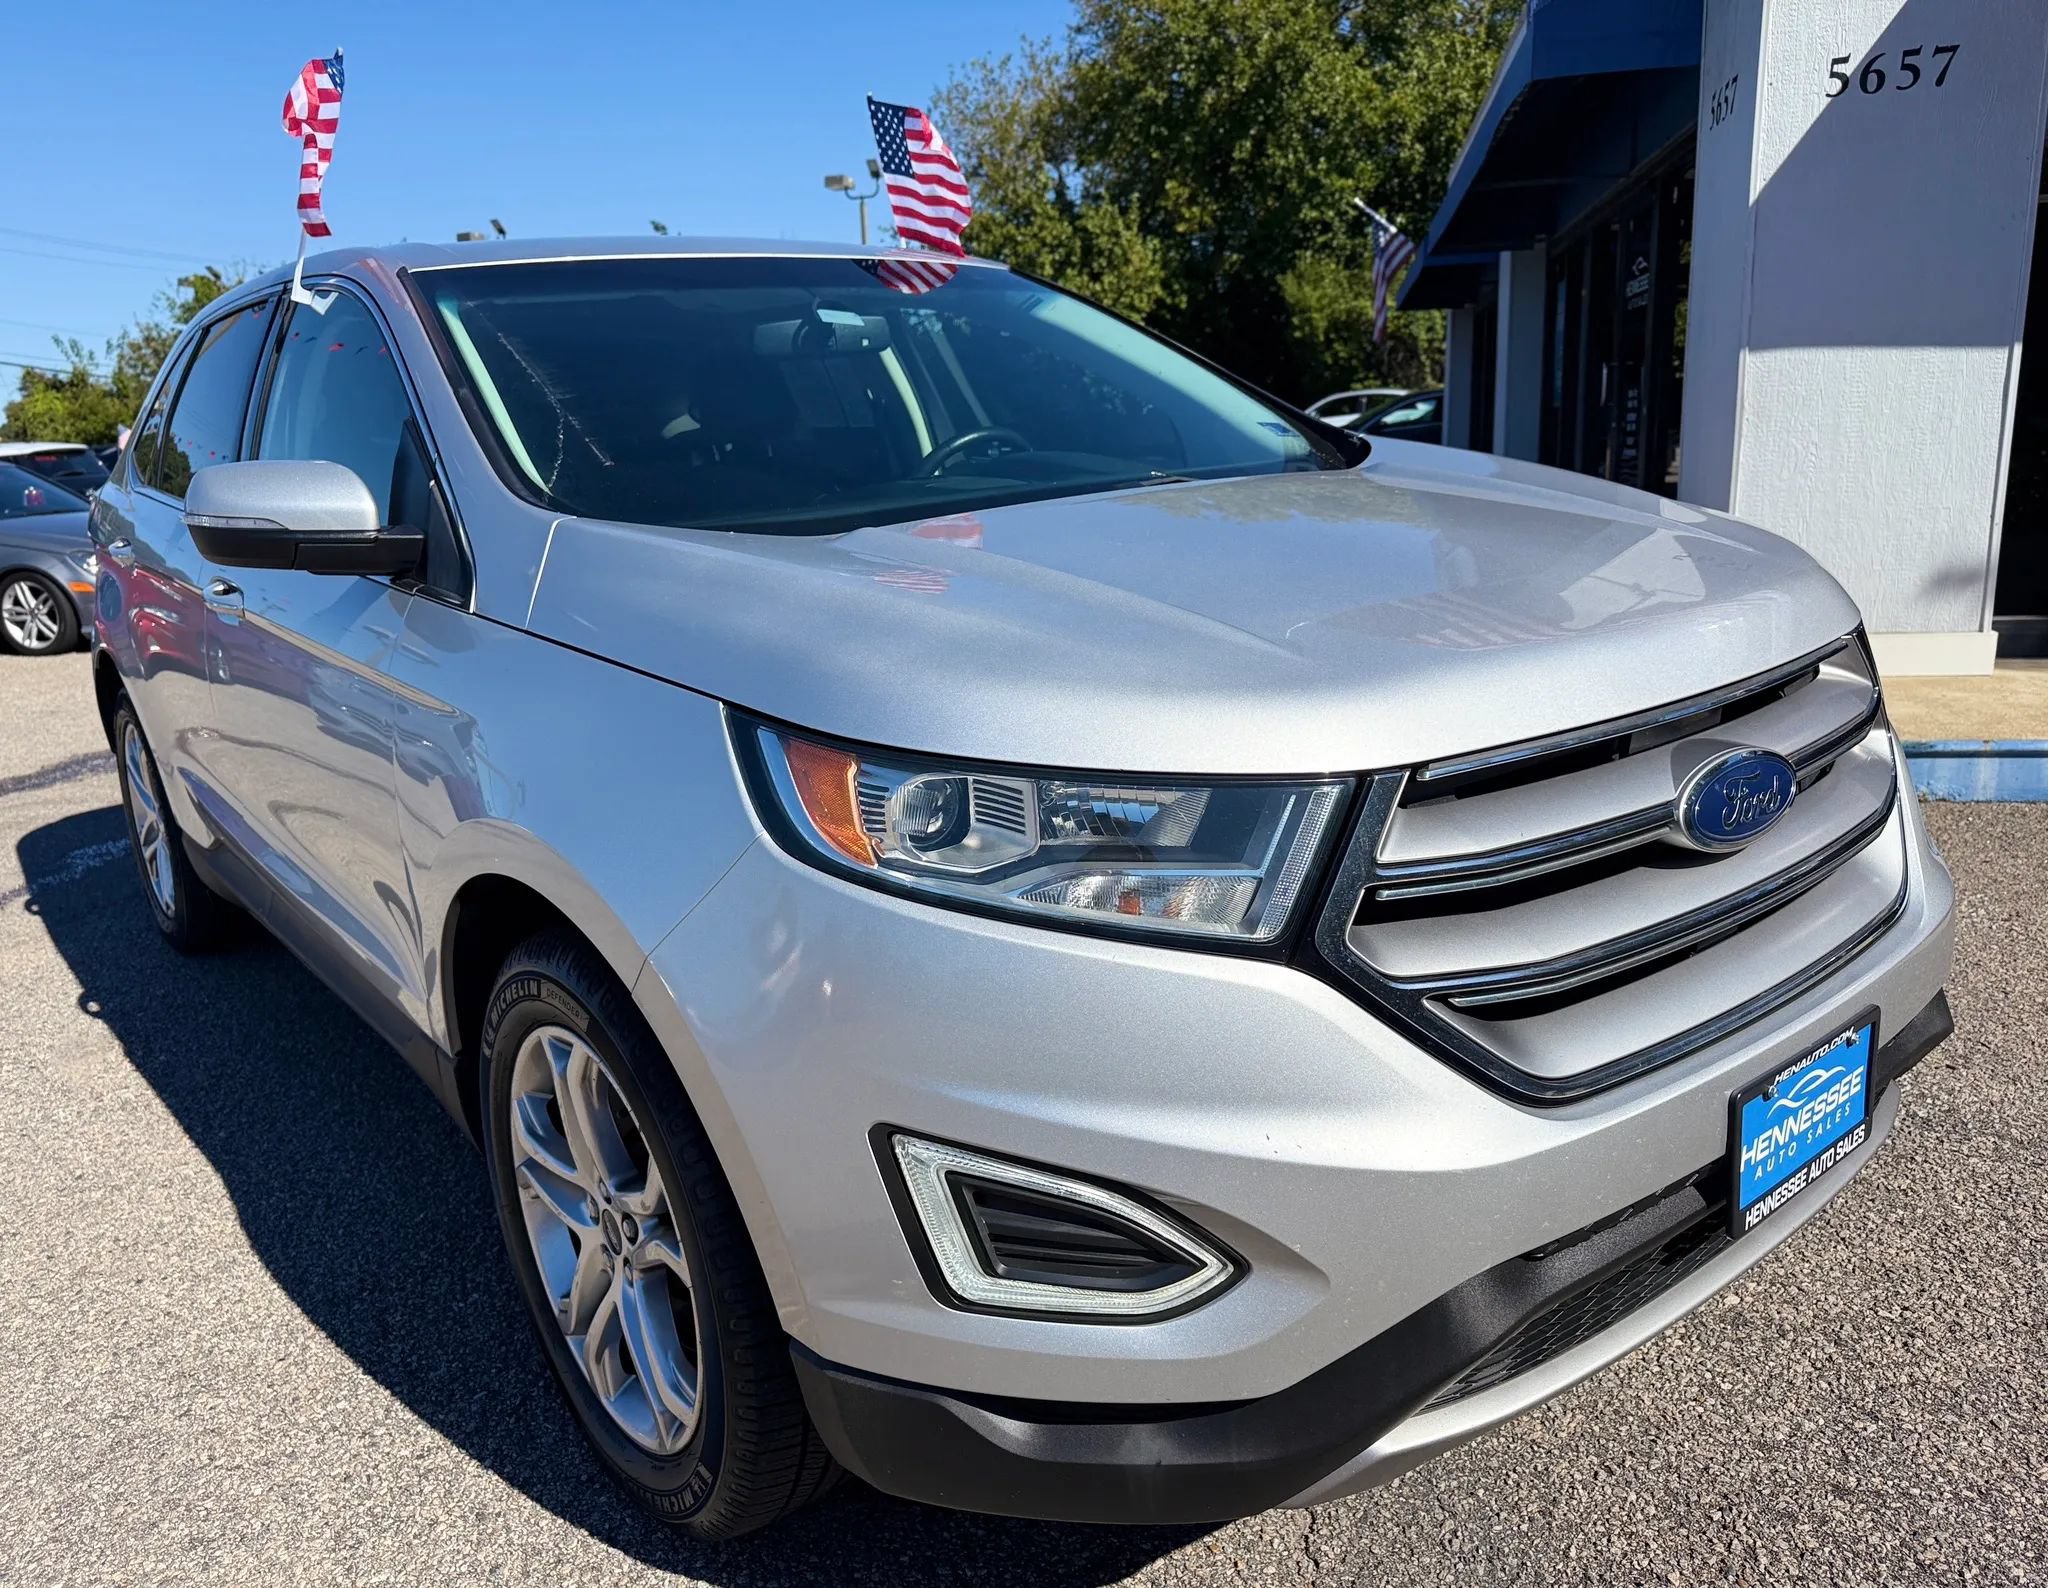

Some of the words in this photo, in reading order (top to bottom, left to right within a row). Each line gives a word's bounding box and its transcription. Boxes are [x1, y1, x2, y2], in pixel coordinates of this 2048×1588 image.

[1825, 44, 1960, 98] 5657
[1709, 73, 1739, 131] 5657
[1721, 769, 1781, 830] Ford
[490, 979, 539, 1027] MICHELIN
[1773, 1026, 1855, 1085] HENAUTO.COM
[1740, 1065, 1865, 1172] HENNESSEE
[1754, 1141, 1797, 1181] AUTO
[1806, 1103, 1852, 1145] SALES
[1744, 1167, 1808, 1231] HENNESSEE
[1808, 1149, 1834, 1186] AUTO
[1835, 1123, 1866, 1163] SALES
